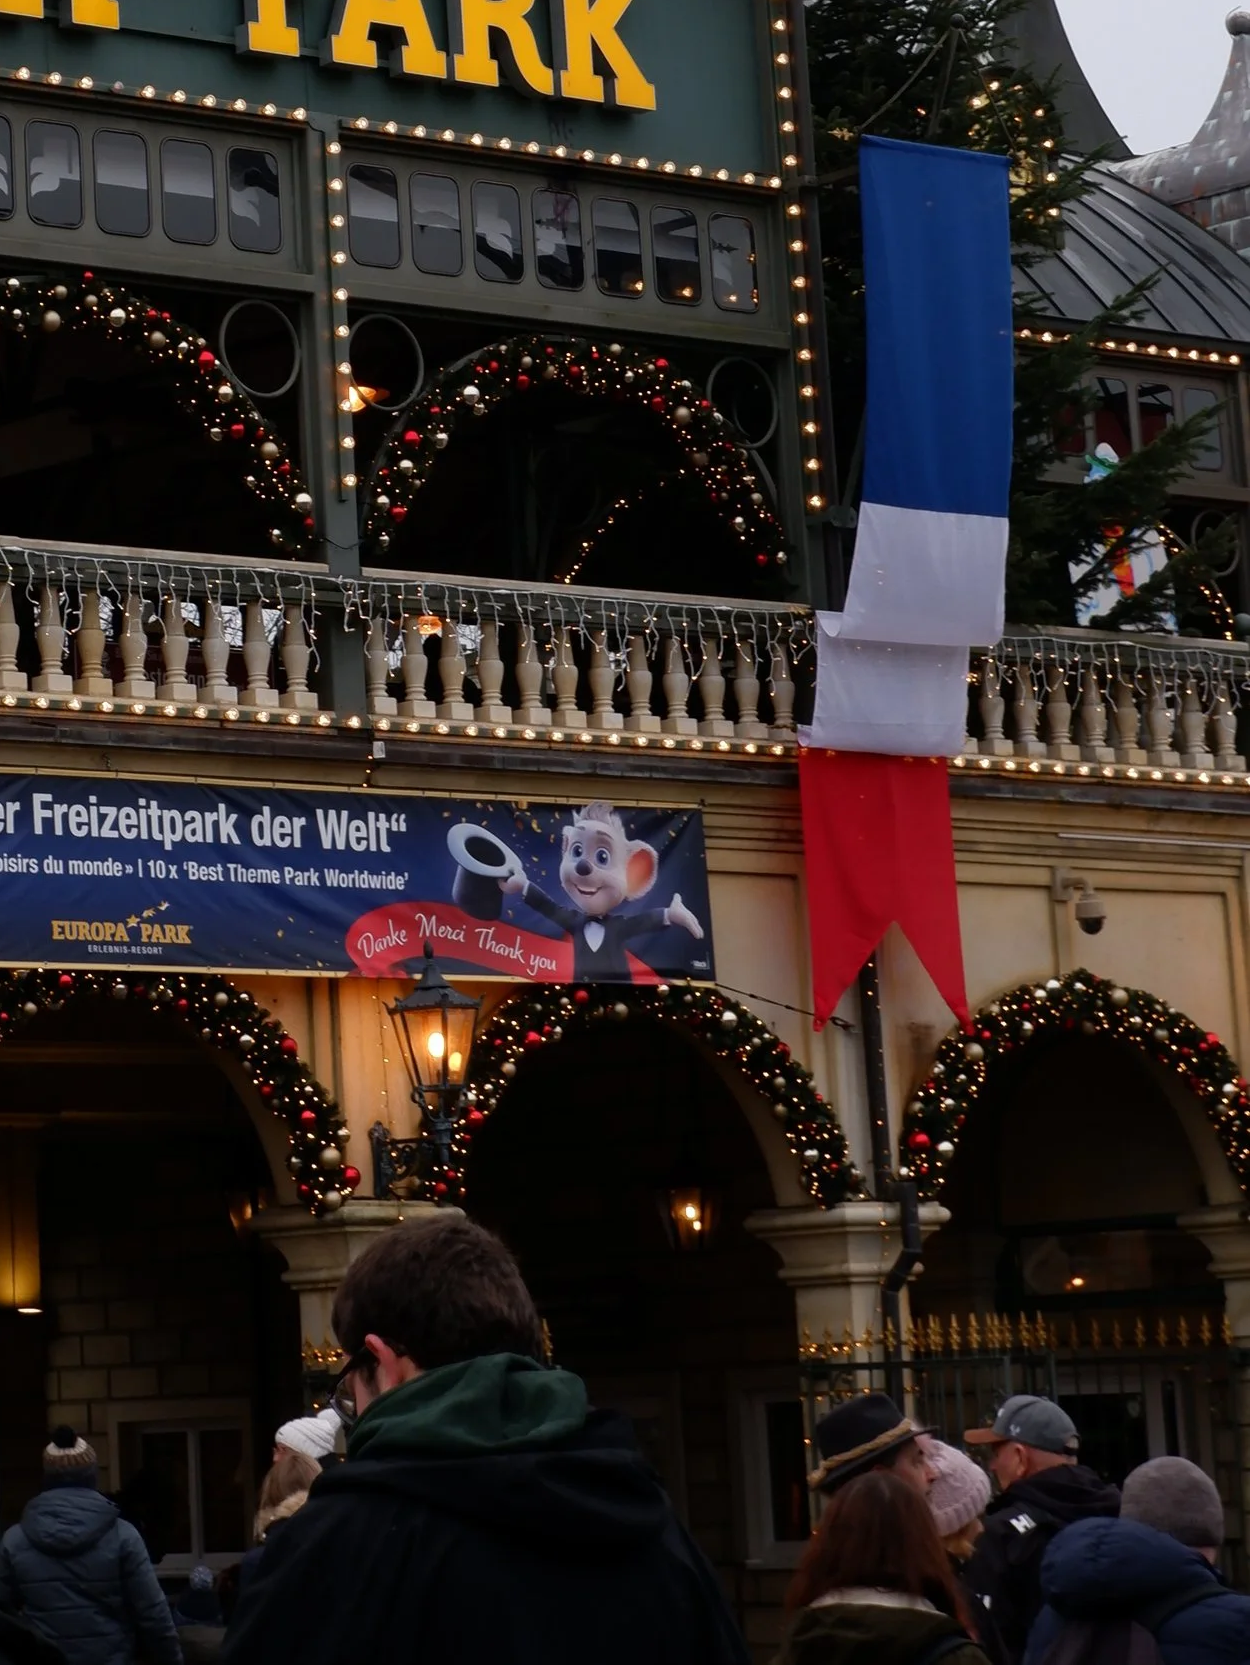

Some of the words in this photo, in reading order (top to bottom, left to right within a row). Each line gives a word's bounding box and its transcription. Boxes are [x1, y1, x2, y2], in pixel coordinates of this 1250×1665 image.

[32, 793, 242, 851] Freizeitpark
[250, 805, 306, 848] der
[43, 854, 64, 875] du
[147, 859, 166, 879] 10
[227, 863, 281, 885] Theme
[284, 866, 321, 886] Park
[51, 920, 130, 942] EUROPA
[140, 923, 192, 944] PARK
[357, 919, 408, 959] Danke
[415, 913, 466, 943] Merci
[475, 926, 525, 964] Thank
[529, 954, 557, 976] you
[88, 944, 163, 955] ERLEBNIS-RESORT
